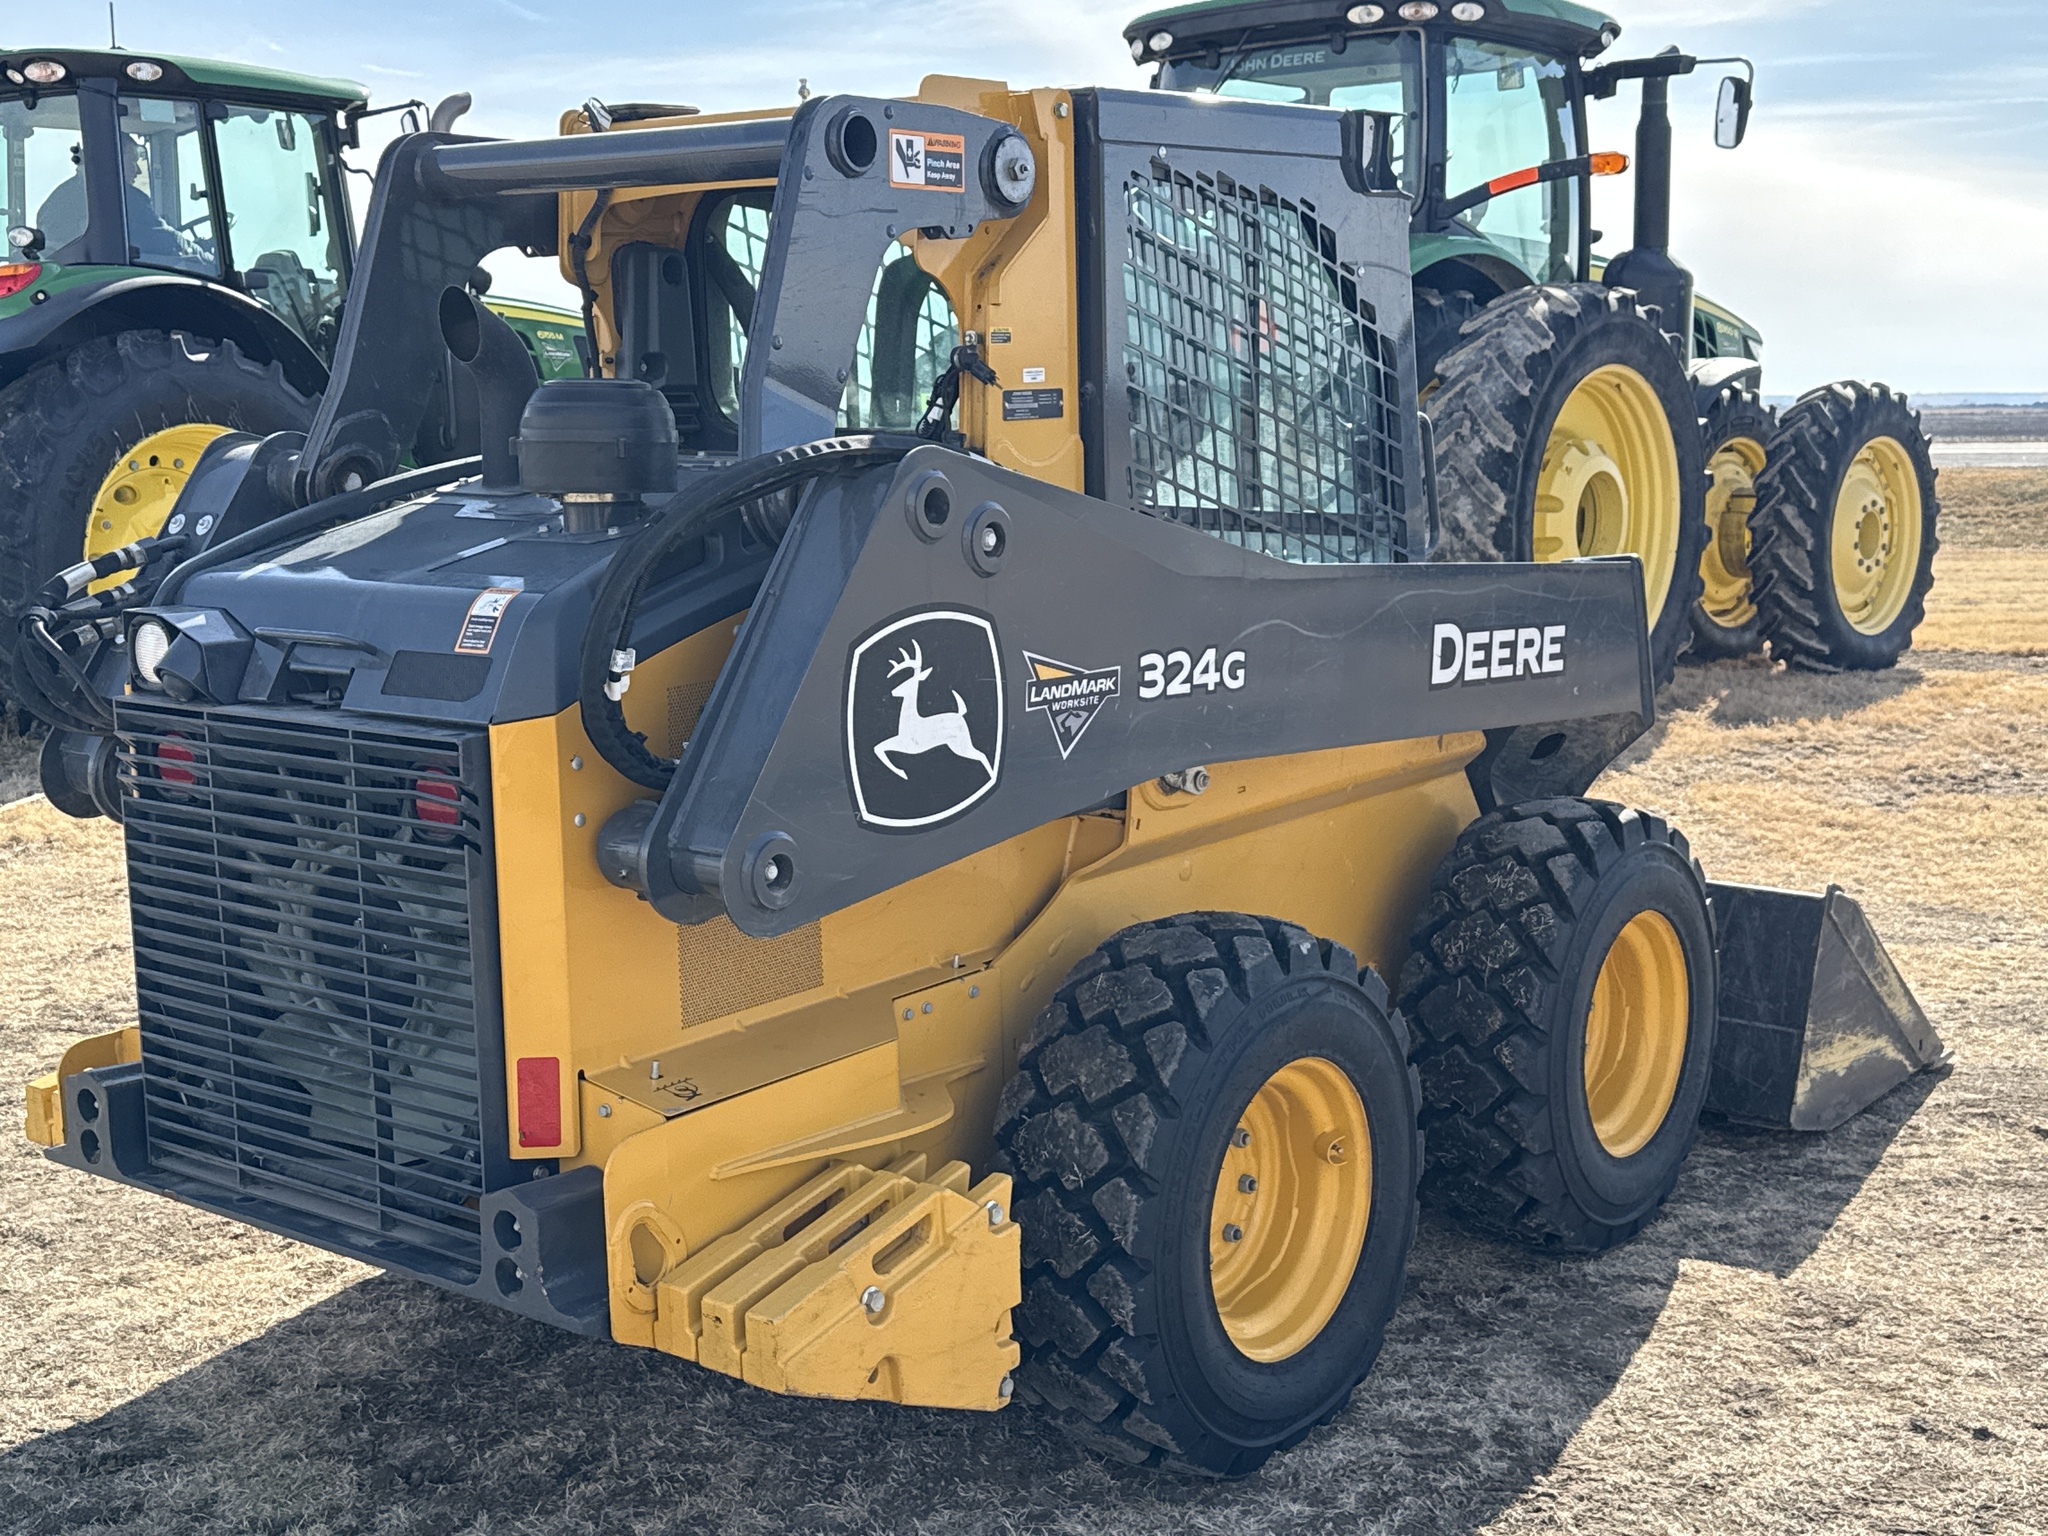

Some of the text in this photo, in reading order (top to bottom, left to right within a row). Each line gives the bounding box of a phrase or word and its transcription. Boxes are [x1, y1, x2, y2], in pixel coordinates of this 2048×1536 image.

[1270, 51, 1325, 69] DEERE
[934, 139, 961, 149] WARNING
[927, 158, 960, 169] Pinch Area
[927, 170, 956, 182] Keep Away
[1431, 623, 1566, 685] DEERE
[1139, 648, 1246, 699] 324G
[1030, 676, 1117, 702] LANDMARK
[1052, 695, 1100, 711] WORKSITE
